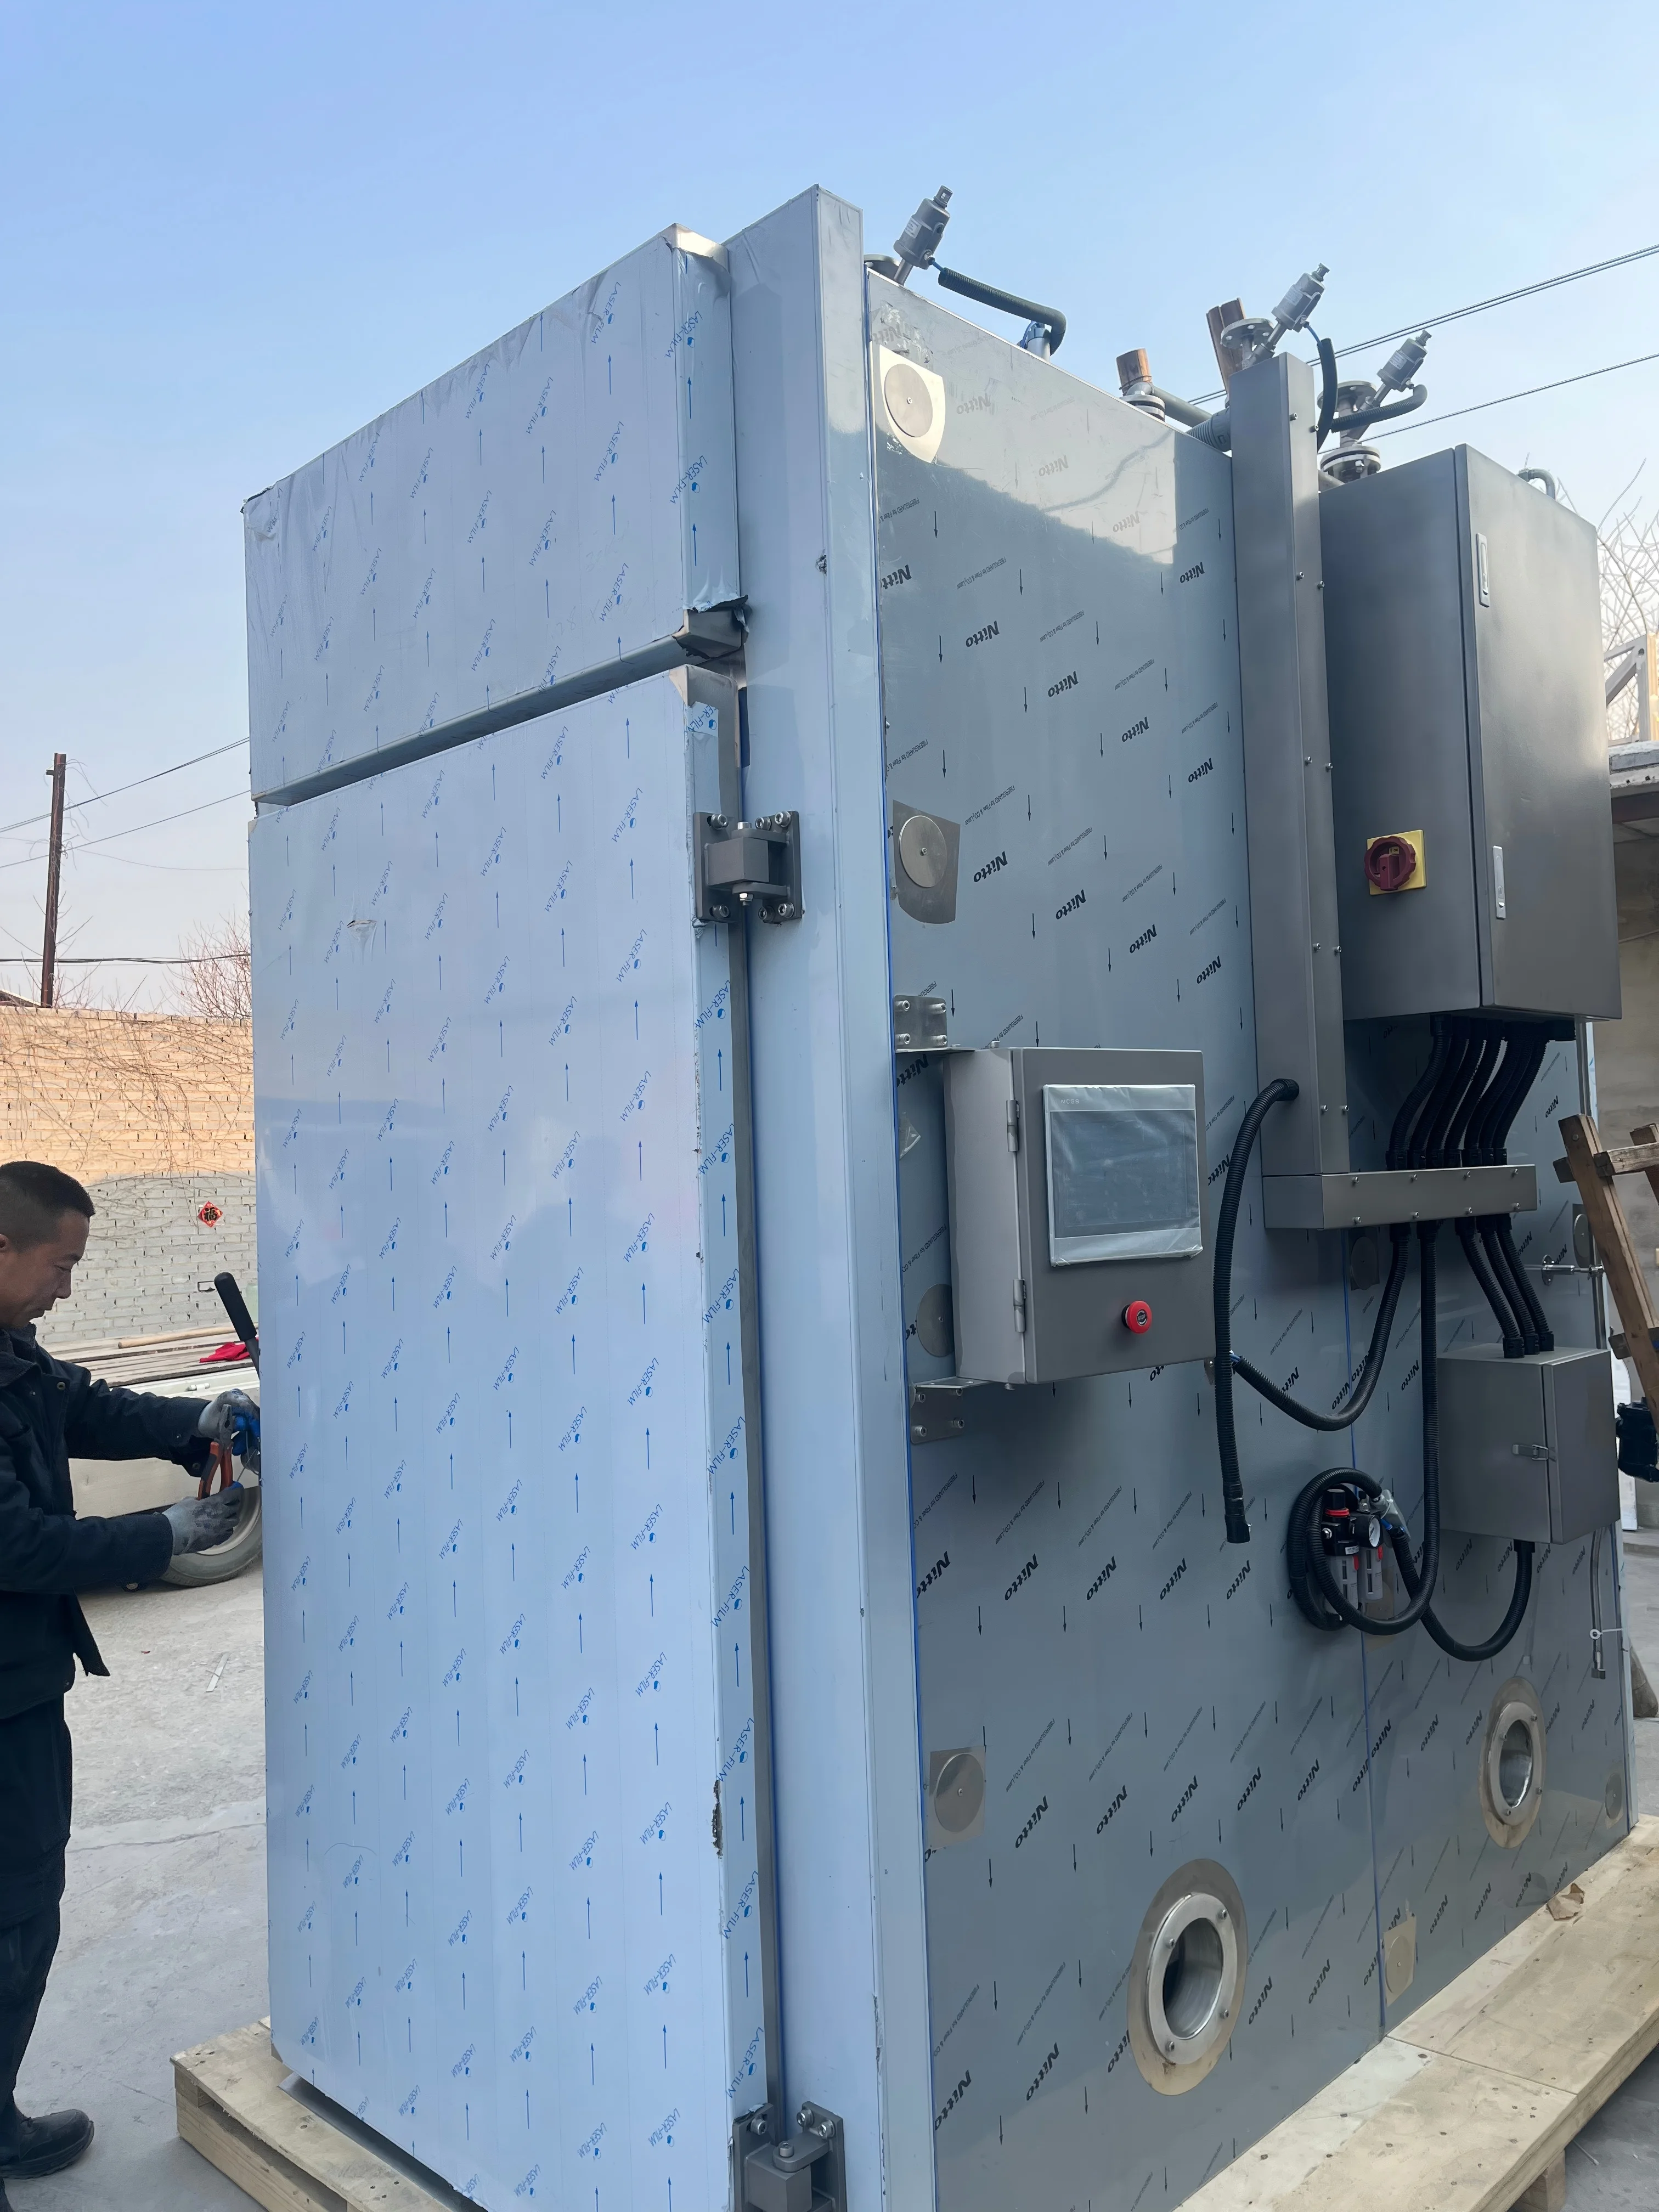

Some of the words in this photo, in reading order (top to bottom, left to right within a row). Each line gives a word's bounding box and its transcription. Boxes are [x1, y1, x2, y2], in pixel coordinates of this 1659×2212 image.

[591, 281, 621, 343] LASER-FILM
[664, 311, 703, 358] LASER-FILM
[465, 363, 490, 419] LASER-FILM
[526, 377, 553, 434] LASER-FILM
[956, 393, 992, 415] Nitto
[359, 432, 380, 482] LASER-FILM
[410, 448, 433, 498] LASER-FILM
[594, 421, 624, 481] LASER-FILM
[1039, 455, 1069, 476] Nitto
[670, 455, 707, 504] LASER-FILM
[467, 490, 492, 543] LASER-FILM
[529, 510, 556, 566] LASER-FILM
[1113, 511, 1140, 532] Nitto
[413, 568, 436, 619] LASER-FILM
[600, 563, 629, 622] LASER-FILM
[881, 565, 912, 590] Nitt
[1180, 562, 1205, 583] Nitto
[314, 616, 334, 661] LASER-FILM
[471, 619, 495, 671] LASER-FILM
[966, 620, 1000, 647] Nitto
[363, 665, 385, 712] LASER-FILM
[1048, 671, 1079, 697] Nitto
[1122, 716, 1149, 742] Nitto
[541, 726, 568, 779] LASER-FILM
[1188, 758, 1214, 782] Nitto
[421, 770, 445, 818] LASER-FILM
[612, 788, 642, 842] LASER-FILM
[321, 807, 341, 851] LASER-FILM
[480, 827, 506, 876] LASER-FILM
[974, 851, 1008, 882] Nitto
[371, 861, 393, 906] LASER-FILM
[544, 860, 573, 912] LASER-FILM
[1056, 889, 1086, 919] Nitto
[278, 889, 296, 930] LASER-FILM
[425, 893, 448, 940] LASER-FILM
[616, 929, 647, 983] LASER-FILM
[1130, 924, 1157, 953] Nitto
[484, 956, 510, 1004] LASER-FILM
[1197, 956, 1221, 984] Nitto
[281, 999, 299, 1040] LASER-FILM
[374, 979, 396, 1023] LASER-FILM
[549, 996, 577, 1046] LASER-FILM
[695, 980, 730, 1029] LASER-FILM
[327, 1035, 346, 1076] LASER-FILM
[428, 1017, 452, 1062] LASER-FILM
[488, 1085, 514, 1132] LASER-FILM
[620, 1071, 651, 1121] LASER-FILM
[283, 1109, 302, 1148] LASER-FILM
[376, 1098, 399, 1141] LASER-FILM
[329, 1149, 349, 1189] LASER-FILM
[431, 1141, 455, 1184] LASER-FILM
[551, 1131, 580, 1179] LASER-FILM
[698, 1124, 735, 1175] LASER-FILM
[285, 1220, 304, 1257] LASER-FILM
[379, 1217, 401, 1259] LASER-FILM
[490, 1215, 516, 1260] LASER-FILM
[623, 1213, 654, 1262] LASER-FILM
[331, 1264, 351, 1304] LASER-FILM
[433, 1266, 457, 1308] LASER-FILM
[555, 1267, 584, 1314] LASER-FILM
[703, 1268, 740, 1323] LASER-FILM
[287, 1331, 306, 1369] LASER-FILM
[381, 1339, 403, 1379] LASER-FILM
[493, 1347, 520, 1390] LASER-FILM
[627, 1358, 659, 1406] LASER-FILM
[1402, 1360, 1419, 1391] Nitto
[333, 1381, 354, 1419] LASER-FILM
[436, 1392, 460, 1434] LASER-FILM
[558, 1406, 587, 1452] LASER-FILM
[708, 1417, 746, 1474] LASER-FILM
[496, 1479, 522, 1521] LASER-FILM
[438, 1519, 463, 1559] LASER-FILM
[630, 1504, 663, 1550] LASER-FILM
[561, 1546, 590, 1589] LASER-FILM
[1005, 1553, 1039, 1600] Nitto
[1087, 1556, 1116, 1600] Nitto
[1160, 1558, 1187, 1600] Nitto
[1227, 1560, 1251, 1600] Nitto
[711, 1566, 749, 1627] LASER-FILM
[499, 1613, 526, 1655] LASER-FILM
[635, 1652, 667, 1697] LASER-FILM
[566, 1688, 595, 1730] LASER-FILM
[716, 1718, 754, 1781] LASER-FILM
[1372, 1719, 1391, 1757] Nitto
[1421, 1714, 1438, 1751] Nitto
[503, 1749, 529, 1788] LASER-FILM
[1238, 1767, 1261, 1811] Nitto
[1298, 1759, 1319, 1801] Nitto
[445, 1778, 470, 1815] LASER-FILM
[1097, 1785, 1127, 1834] Nitto
[1171, 1775, 1198, 1822] Nitto
[640, 1802, 672, 1844] LASER-FILM
[1015, 1796, 1048, 1848] Nitto
[569, 1831, 599, 1871] LASER-FILM
[506, 1886, 533, 1925] LASER-FILM
[722, 1871, 759, 1939] LASER-FILM
[1430, 1895, 1448, 1933] Nitto
[573, 1976, 602, 2015] LASER-FILM
[644, 1954, 676, 1995] LASER-FILM
[1309, 1959, 1330, 2004] Nitto
[1249, 1976, 1272, 2024] Nitto
[510, 2026, 537, 2063] LASER-FILM
[725, 2027, 763, 2098] LASER-FILM
[1108, 2030, 1130, 2073] itto
[1026, 2042, 1059, 2101] Nitto
[935, 2070, 972, 2131] Nitto
[577, 2123, 607, 2159] LASER-FILM
[648, 2108, 680, 2147] LASER-FILM
